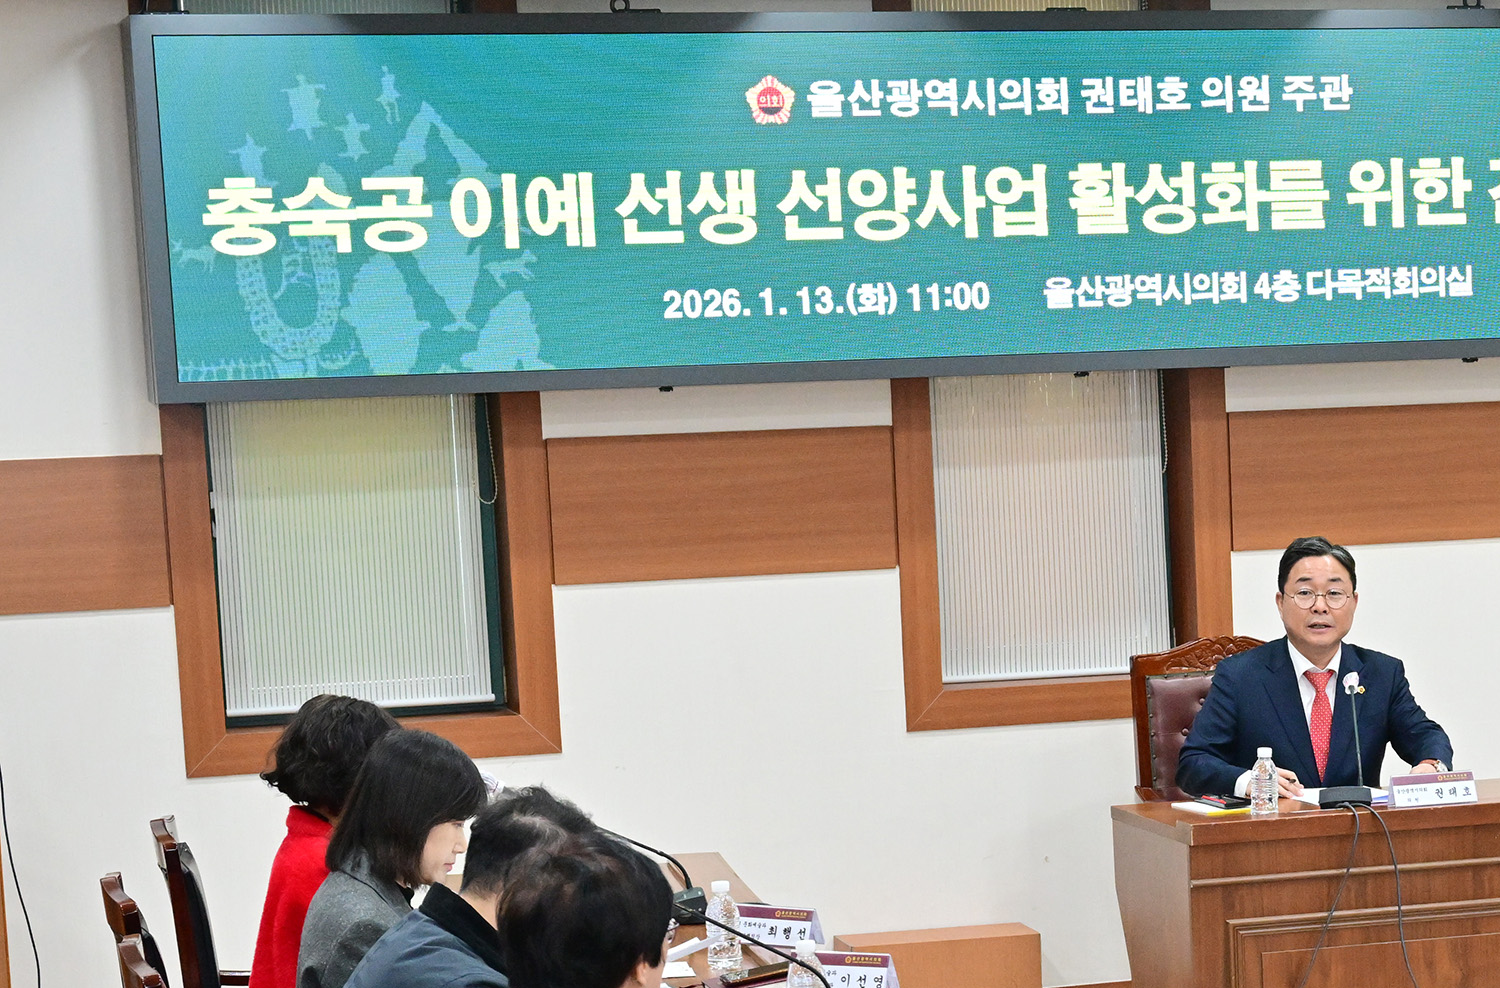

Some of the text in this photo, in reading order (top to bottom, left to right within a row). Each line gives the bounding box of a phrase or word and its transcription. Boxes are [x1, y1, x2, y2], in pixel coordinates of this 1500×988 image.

[806, 73, 1354, 118] 울산광역시의회 권태호 의원 주관
[201, 175, 434, 257] 충숙공
[449, 171, 597, 249] 이예
[614, 169, 759, 245] 선생
[776, 163, 1049, 242] 선양사업
[1068, 159, 1330, 235] 활성화를
[1345, 156, 1473, 229] 위한
[663, 281, 990, 319] 2026. 1. 13.(화) 11:00
[1043, 264, 1474, 309] 울산광역시의회 4층 다목적회의실
[768, 925, 807, 940] 최행선
